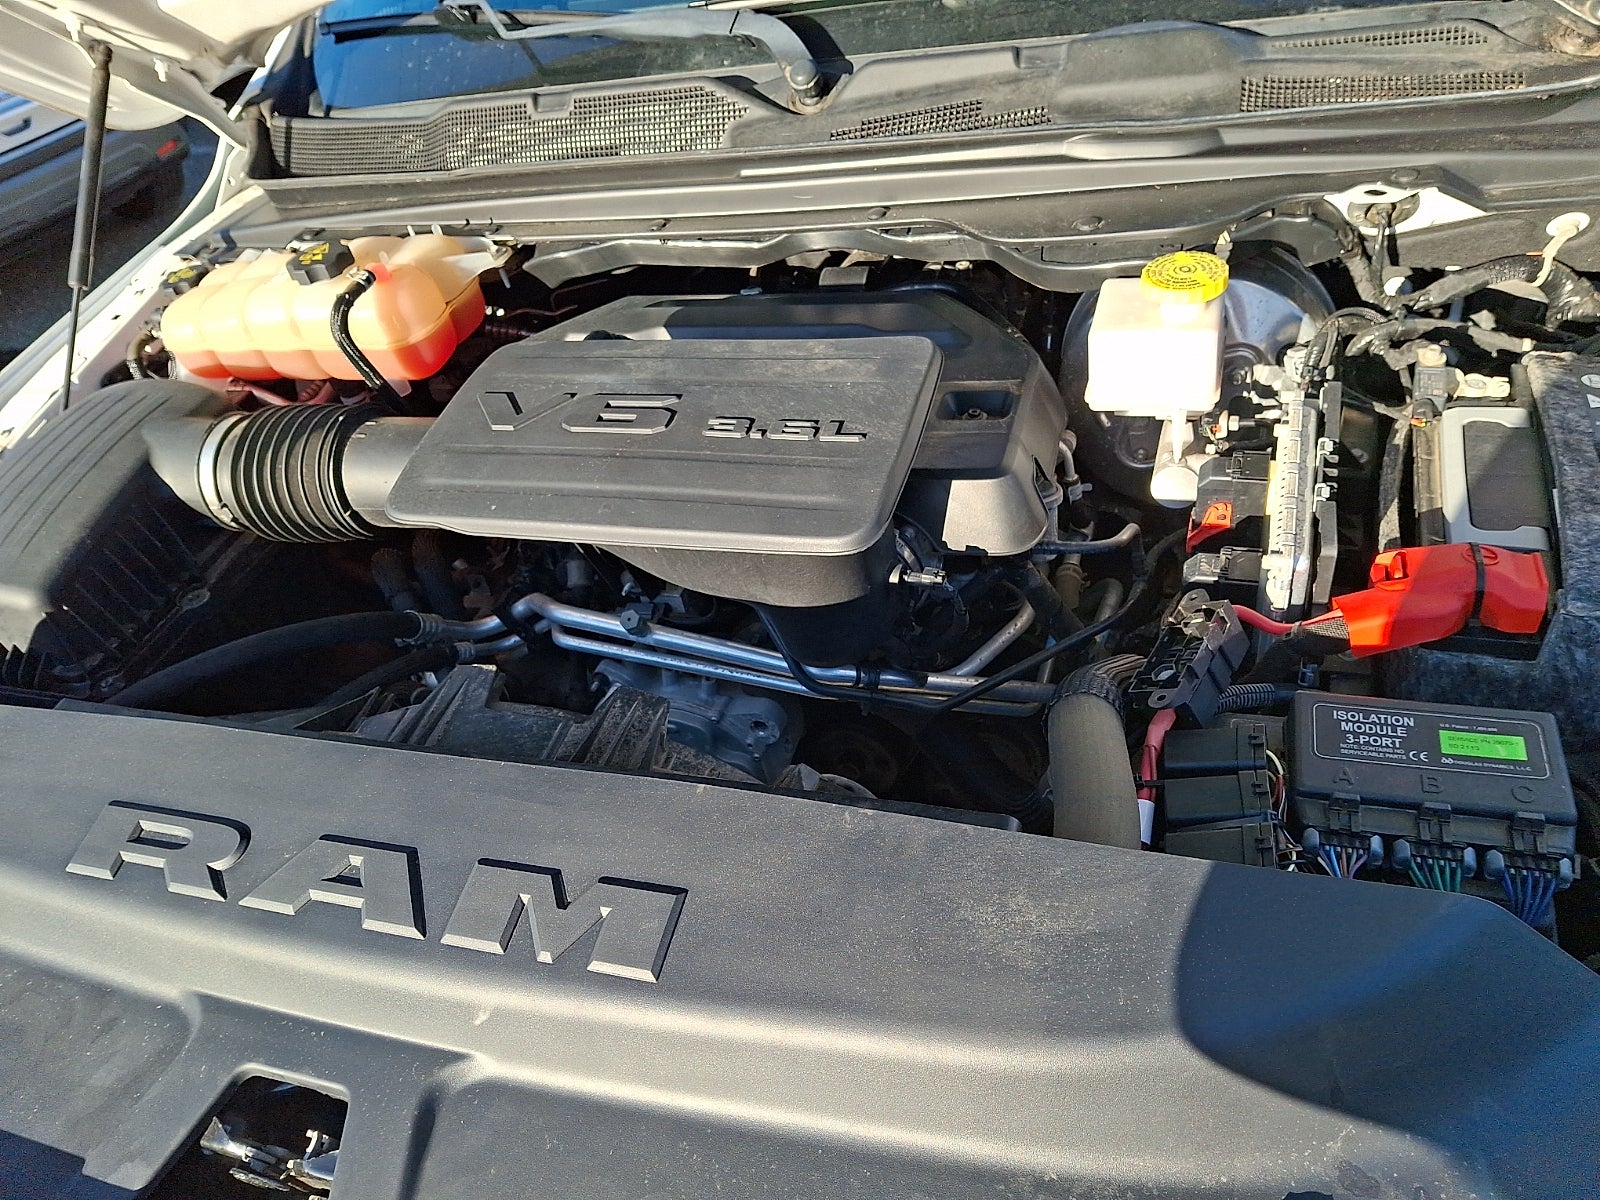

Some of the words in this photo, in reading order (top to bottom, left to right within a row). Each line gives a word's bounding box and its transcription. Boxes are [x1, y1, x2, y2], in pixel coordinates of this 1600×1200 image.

[476, 392, 684, 435] V6
[702, 416, 868, 442] 3.6L
[1333, 710, 1415, 727] ISOLATION
[1340, 722, 1408, 737] MODULE
[1345, 734, 1403, 748] 3-PORT
[1361, 745, 1394, 754] CONTAINS
[1340, 748, 1385, 758] SERVICEABLE
[1385, 752, 1407, 760] PARTS
[1333, 767, 1354, 786] A
[1420, 773, 1444, 795] B
[1511, 785, 1535, 804] C
[65, 800, 689, 983] RAM
